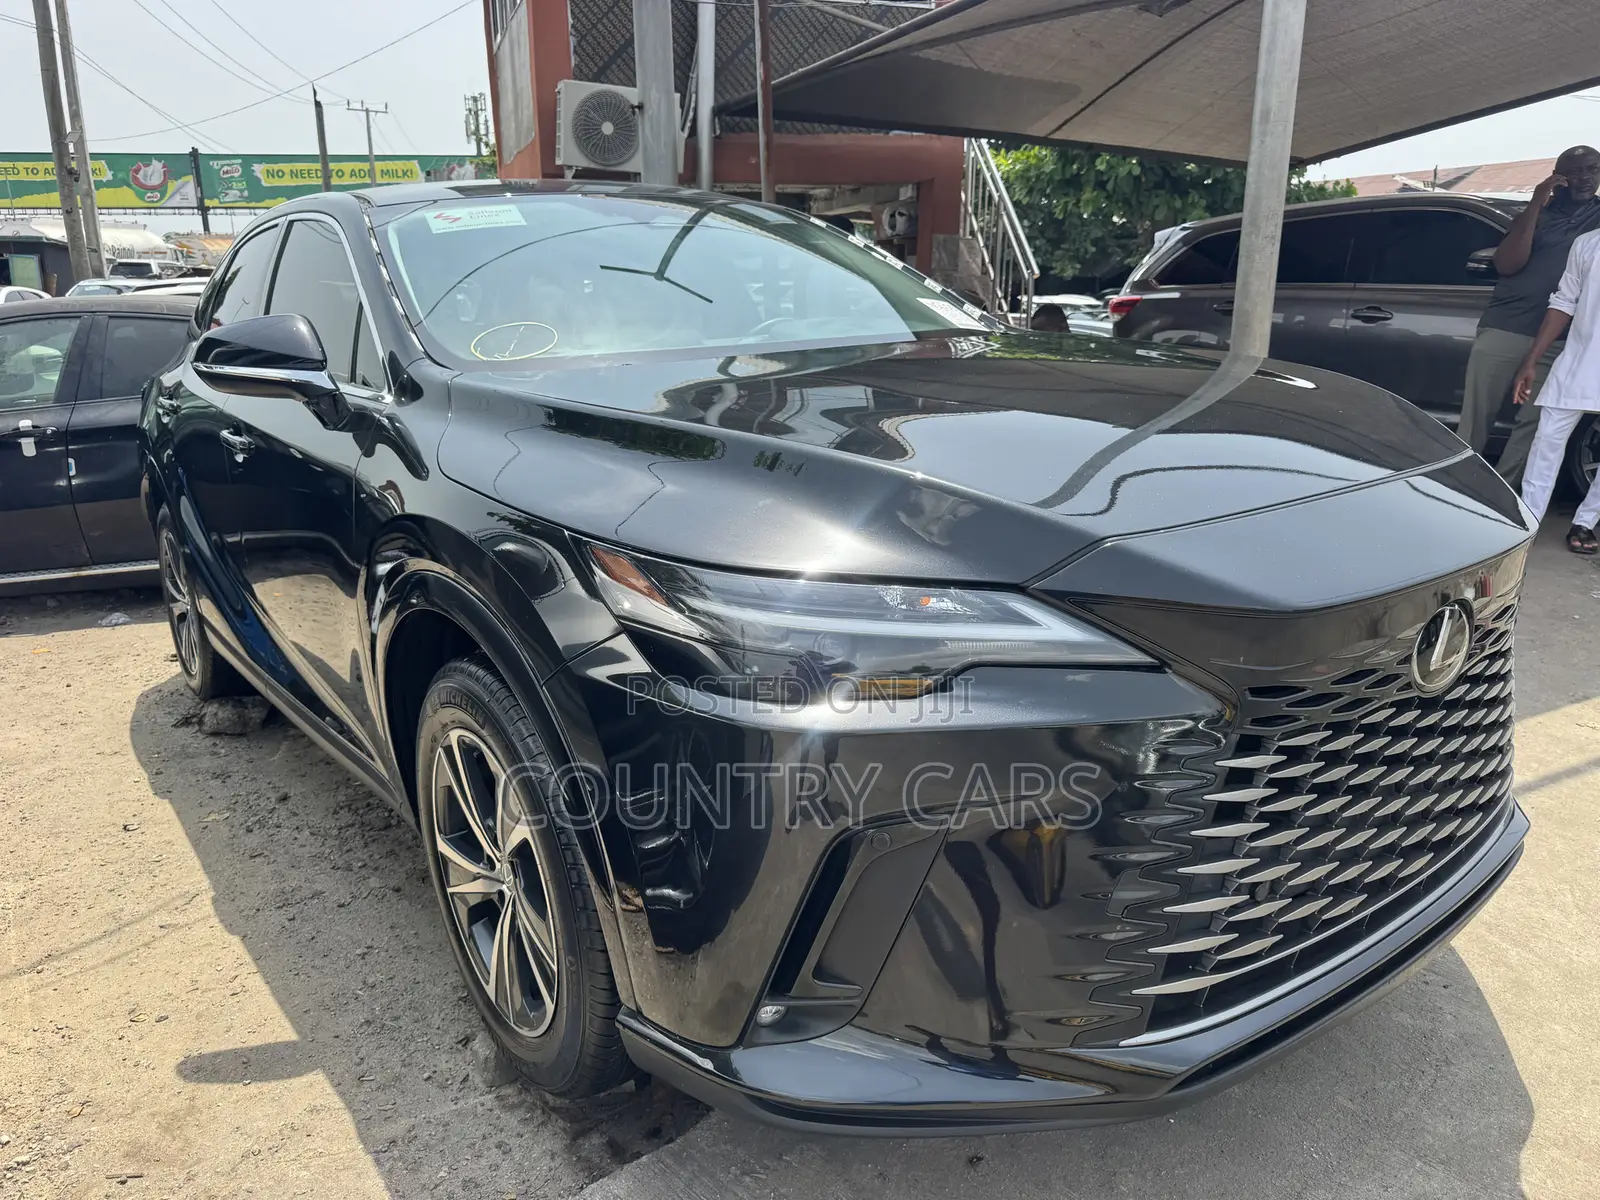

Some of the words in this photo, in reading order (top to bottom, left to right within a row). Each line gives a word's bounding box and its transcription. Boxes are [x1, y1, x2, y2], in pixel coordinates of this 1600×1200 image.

[0, 166, 20, 176] EED
[23, 167, 40, 176] TO
[265, 168, 286, 179] NO
[290, 168, 323, 179] NEED
[350, 168, 372, 179] AD
[380, 167, 414, 179] MILK!
